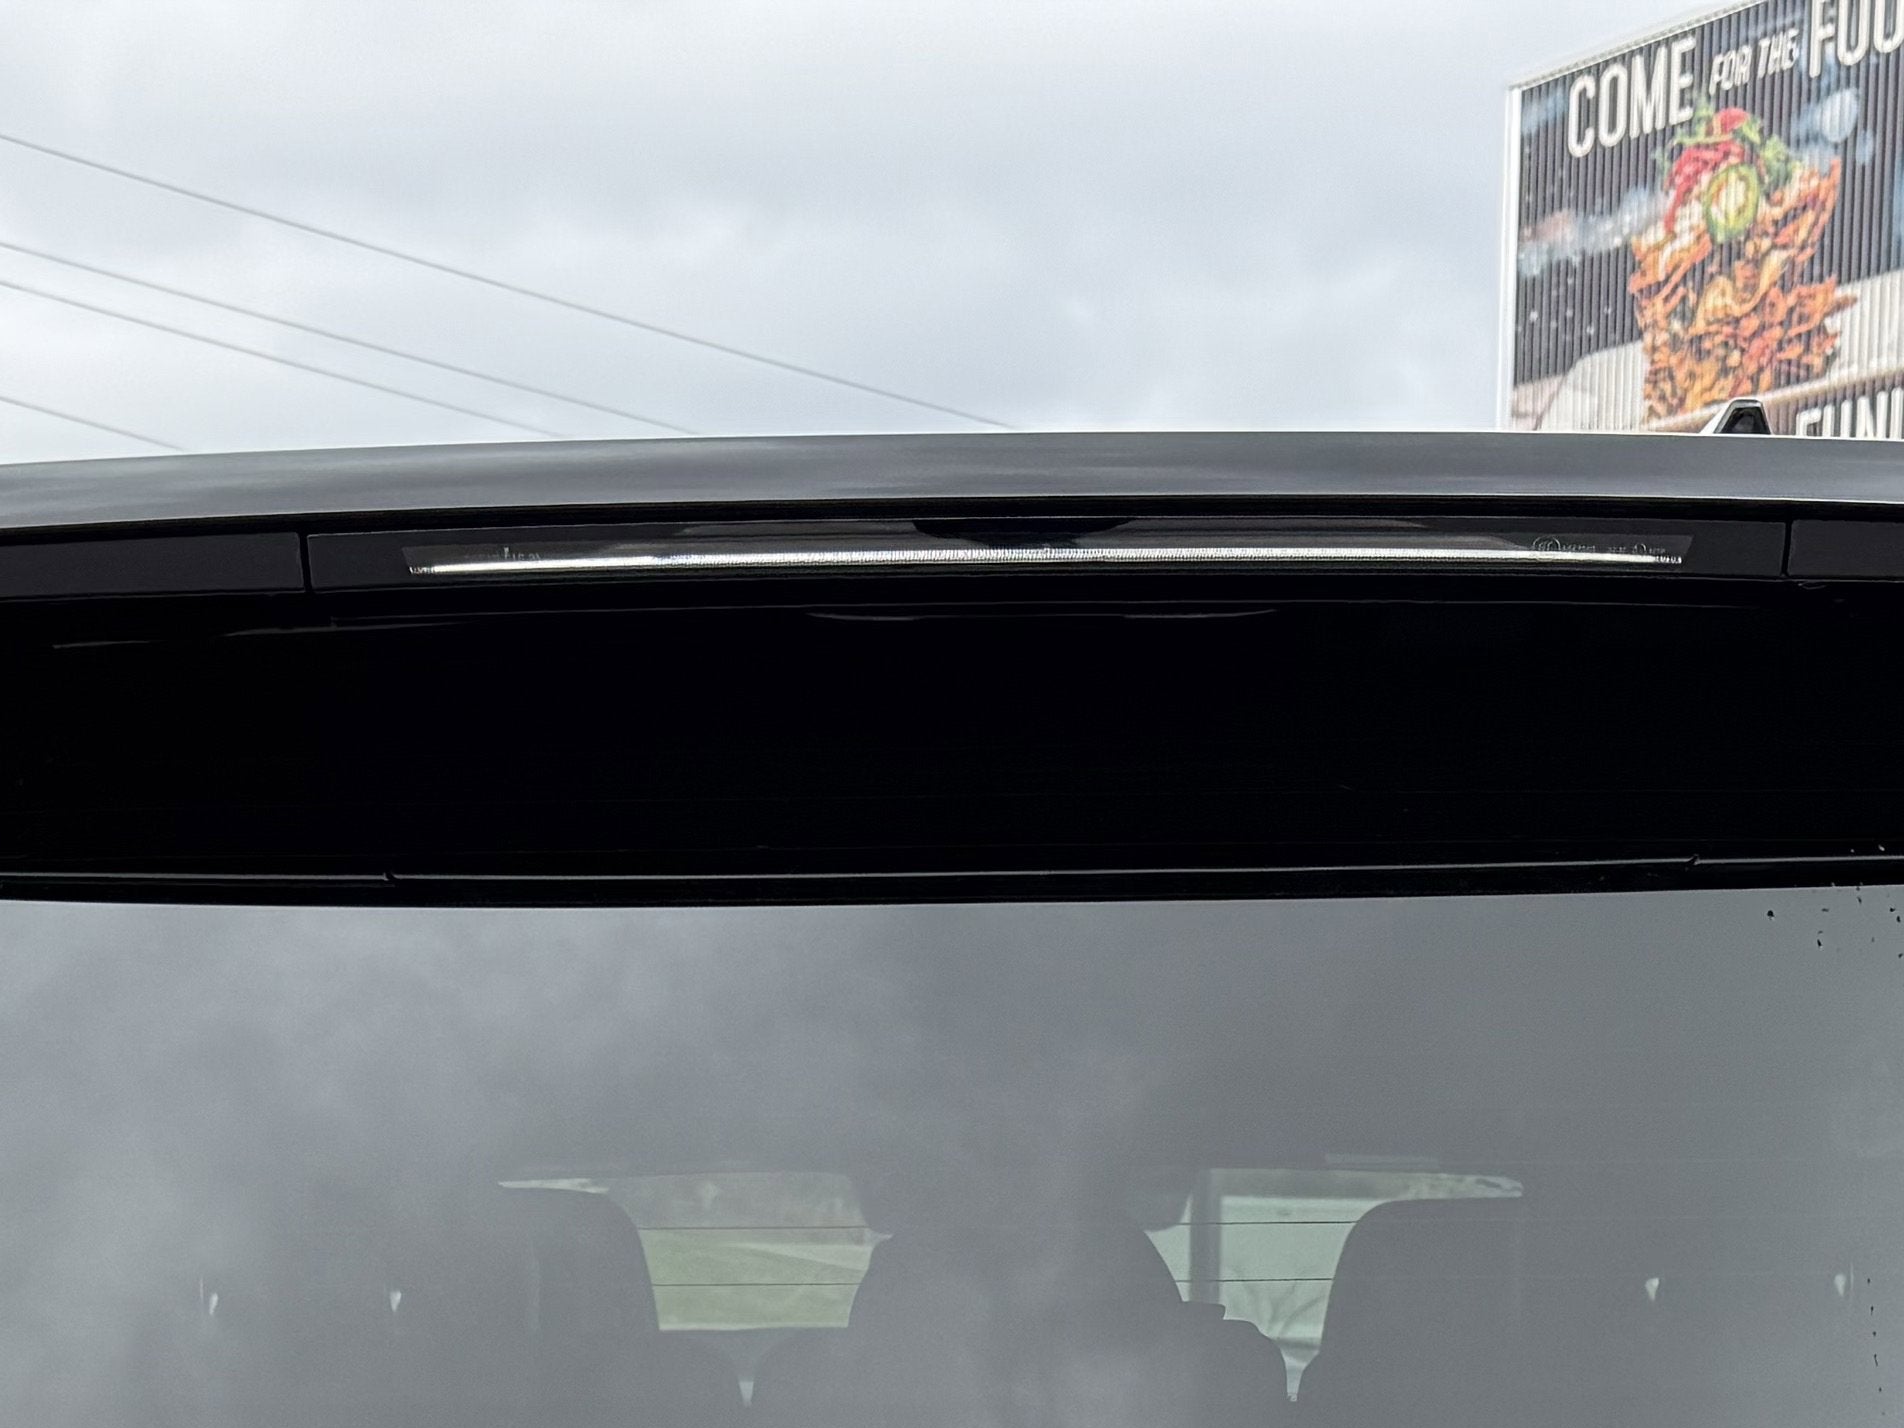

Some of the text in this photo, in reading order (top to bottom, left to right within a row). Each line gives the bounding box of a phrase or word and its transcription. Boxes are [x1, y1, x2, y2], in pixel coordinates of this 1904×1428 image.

[1567, 36, 1696, 158] COME
[1709, 45, 1751, 96] FOR
[1757, 28, 1800, 79] THE
